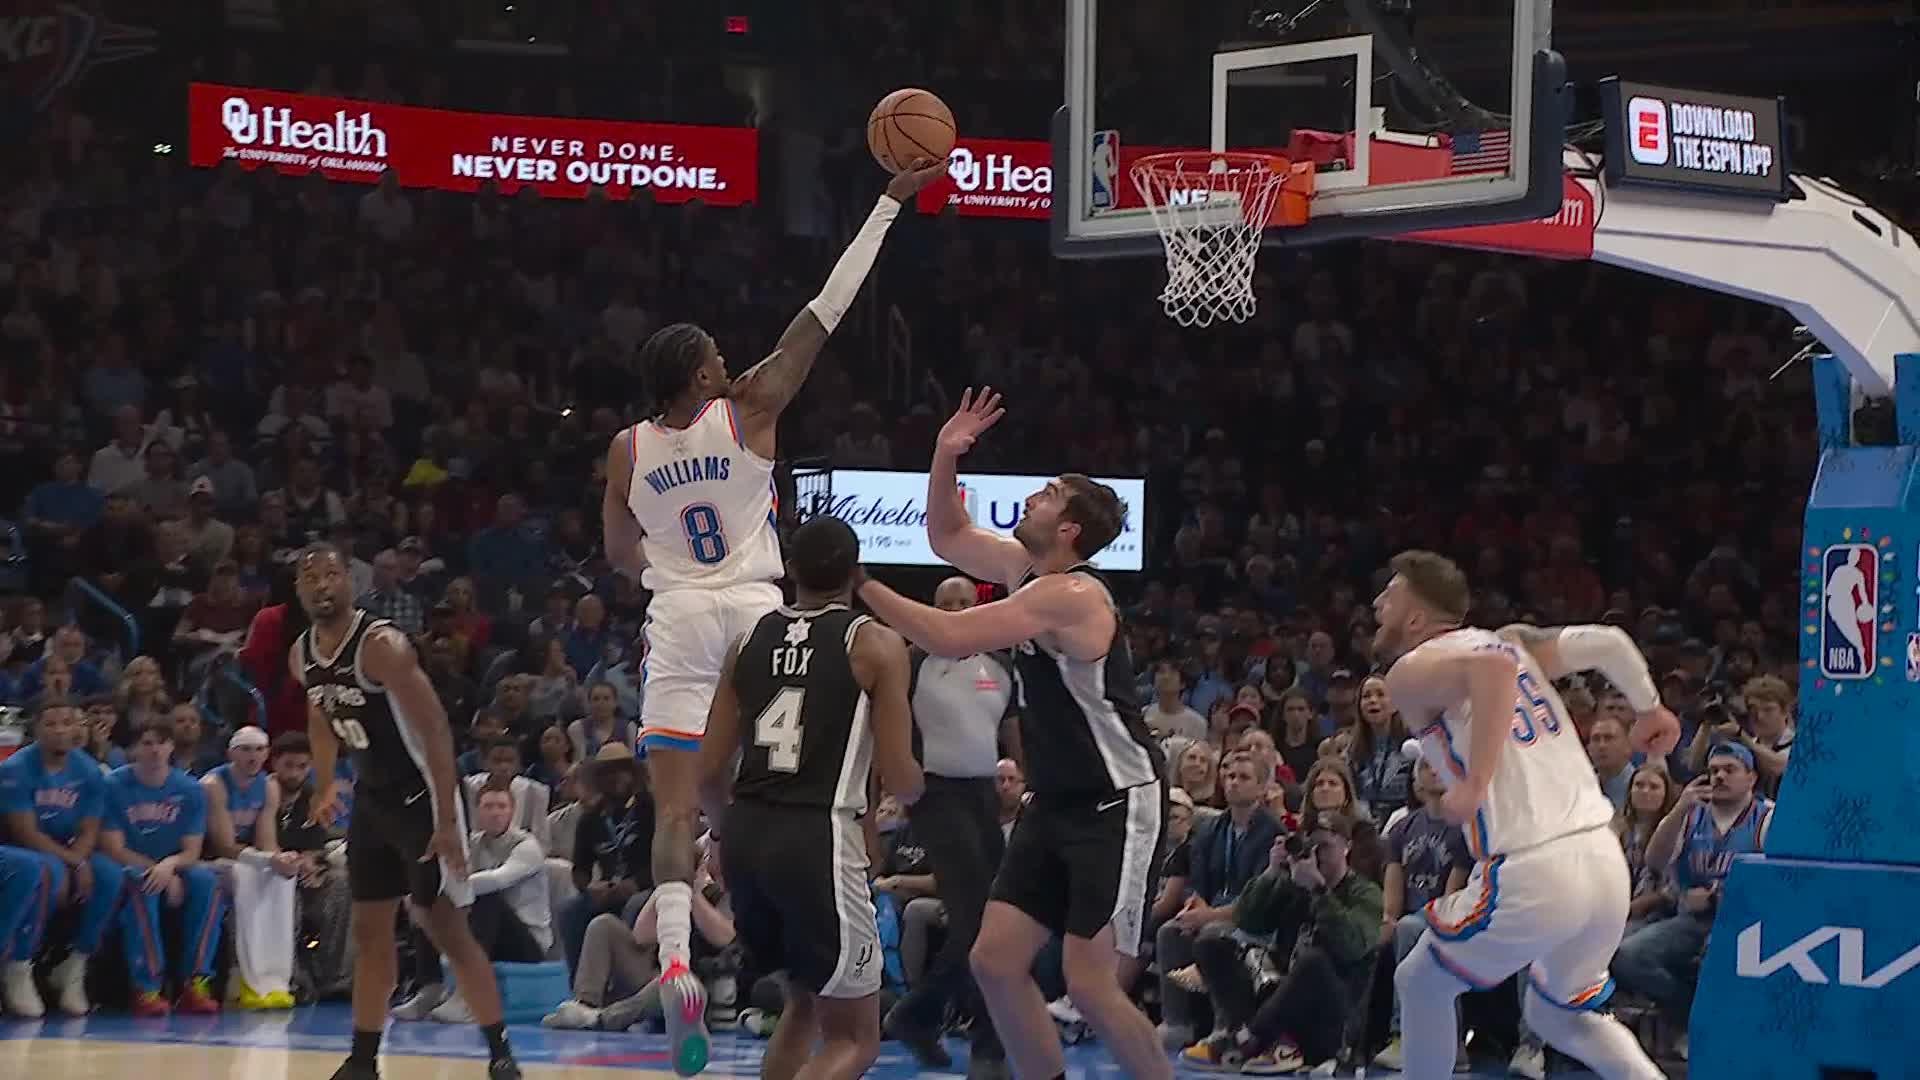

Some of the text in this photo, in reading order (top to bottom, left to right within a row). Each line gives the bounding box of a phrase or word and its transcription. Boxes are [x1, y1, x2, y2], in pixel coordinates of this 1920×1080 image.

[222, 97, 388, 157] OU Health
[1671, 102, 1755, 142] DOWNLOAD
[239, 148, 308, 166] UNIVERSITY
[308, 155, 322, 168] of
[321, 155, 388, 173] OKLAHOMA
[491, 136, 584, 156] NEVER
[1673, 136, 1773, 178] THE ESPN APP
[452, 153, 727, 190] NEVER OUTDONE.
[948, 148, 1052, 193] OU Hea
[963, 195, 1028, 208] UNIVERSITY
[1028, 198, 1041, 210] of
[644, 456, 730, 495] WILLIAMS
[680, 501, 730, 565] 8
[771, 647, 814, 676] FOX
[1828, 647, 1855, 670] NBA
[754, 686, 806, 773] 4
